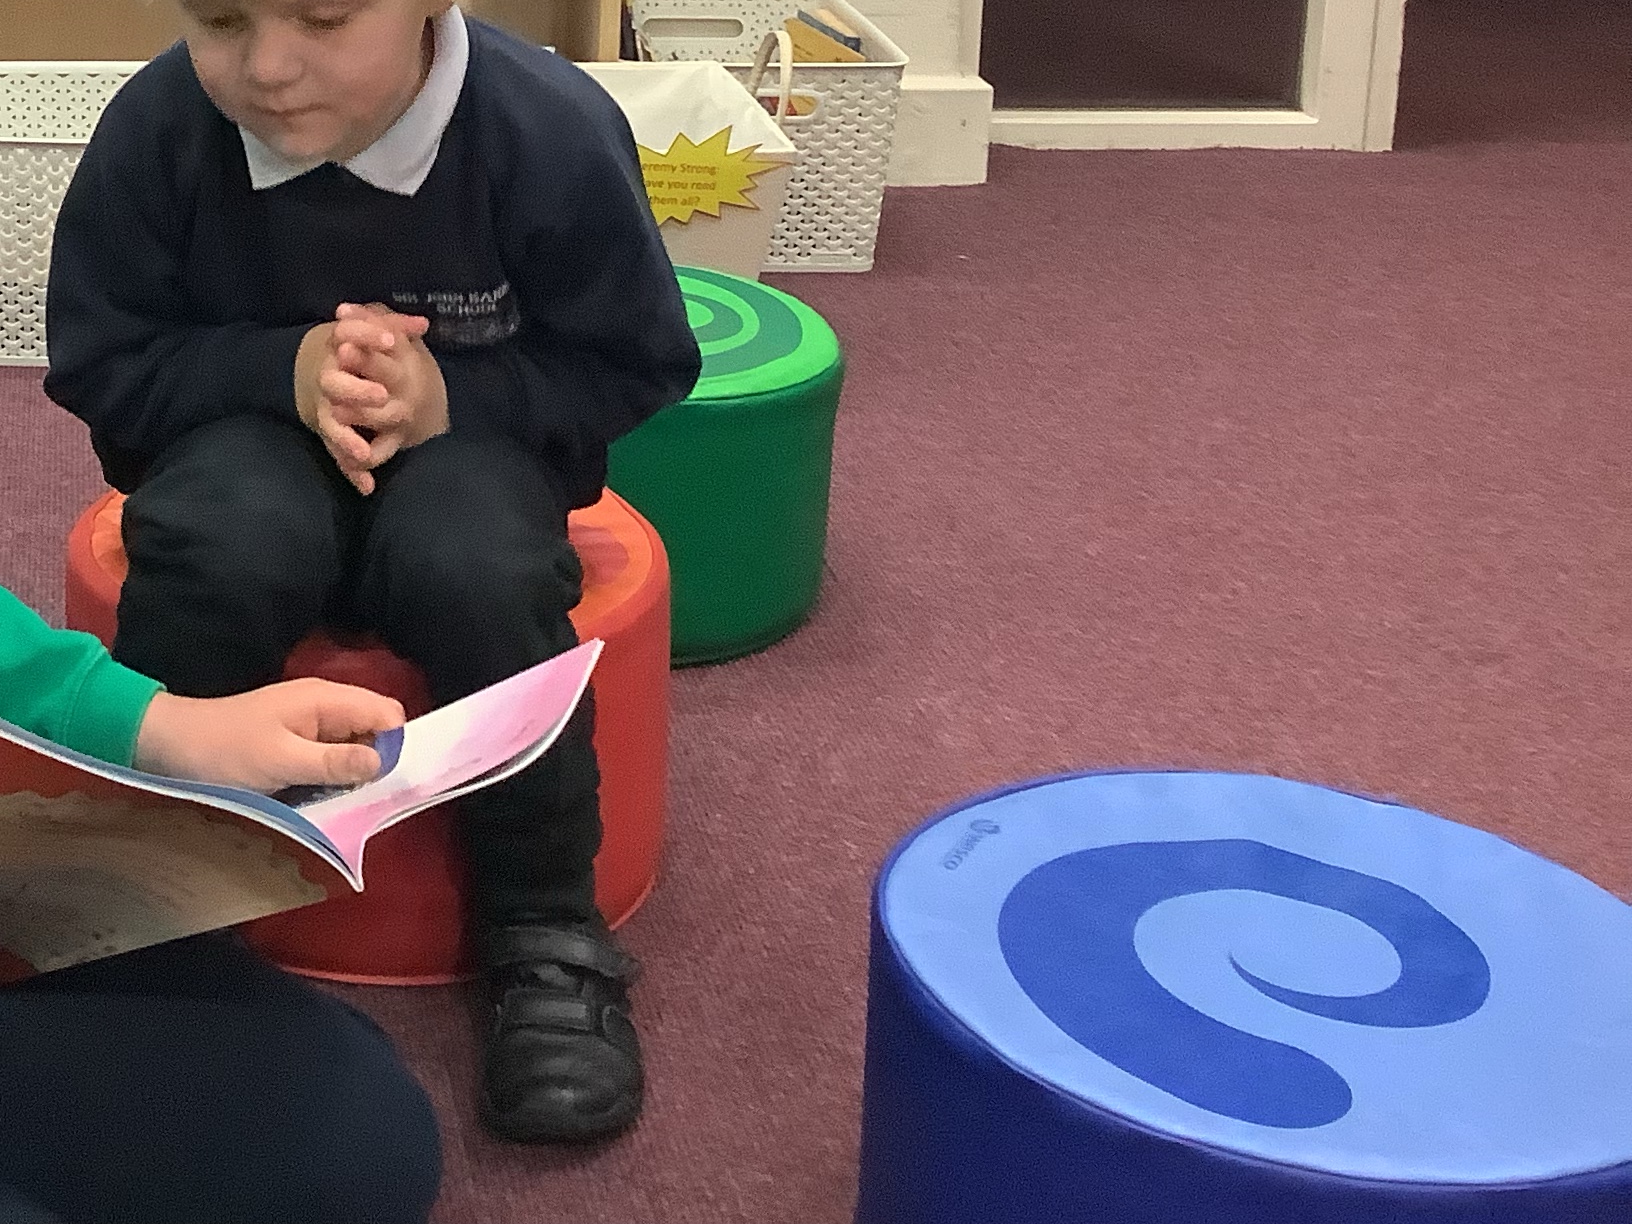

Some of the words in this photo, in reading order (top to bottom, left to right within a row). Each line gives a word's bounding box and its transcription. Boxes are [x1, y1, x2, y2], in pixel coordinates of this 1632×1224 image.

[642, 163, 677, 173] eremy
[646, 180, 664, 188] ave
[668, 181, 688, 190] you
[691, 181, 716, 190] read
[680, 196, 700, 206] all?
